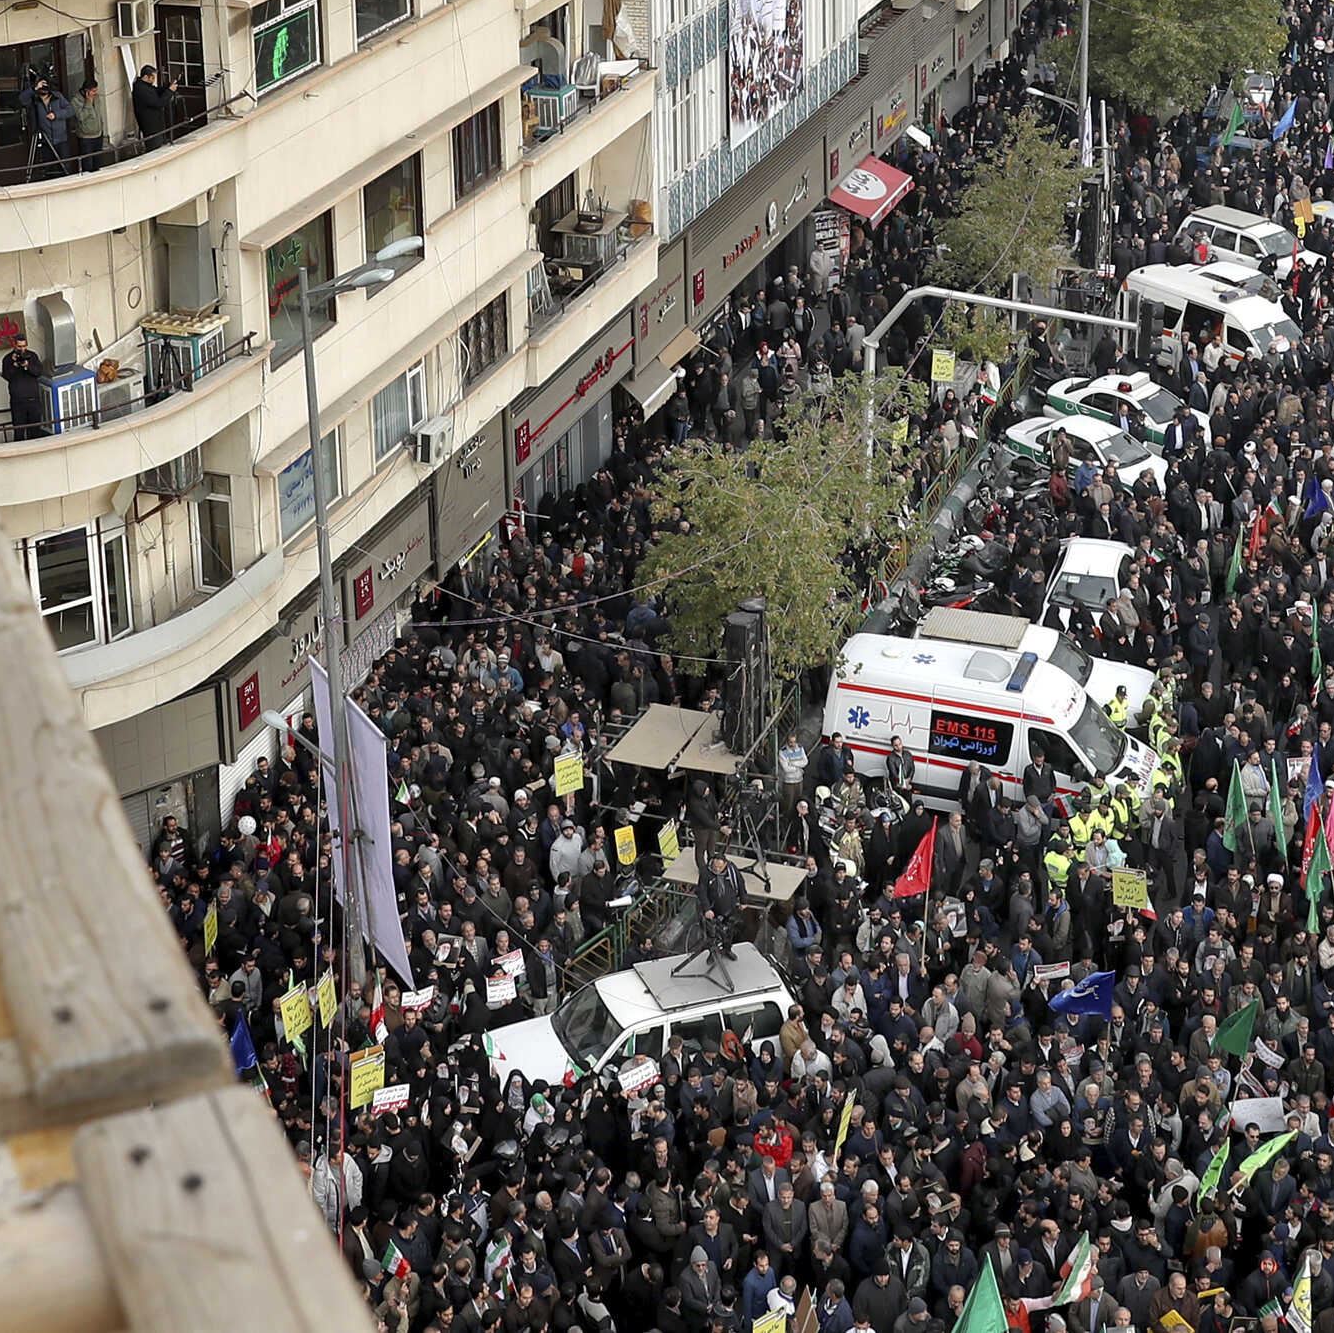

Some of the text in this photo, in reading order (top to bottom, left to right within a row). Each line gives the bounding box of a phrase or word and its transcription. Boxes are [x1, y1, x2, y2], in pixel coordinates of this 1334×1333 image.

[244, 681, 255, 697] 50
[935, 718, 996, 740] EMS 115
[933, 735, 959, 747] تهران
